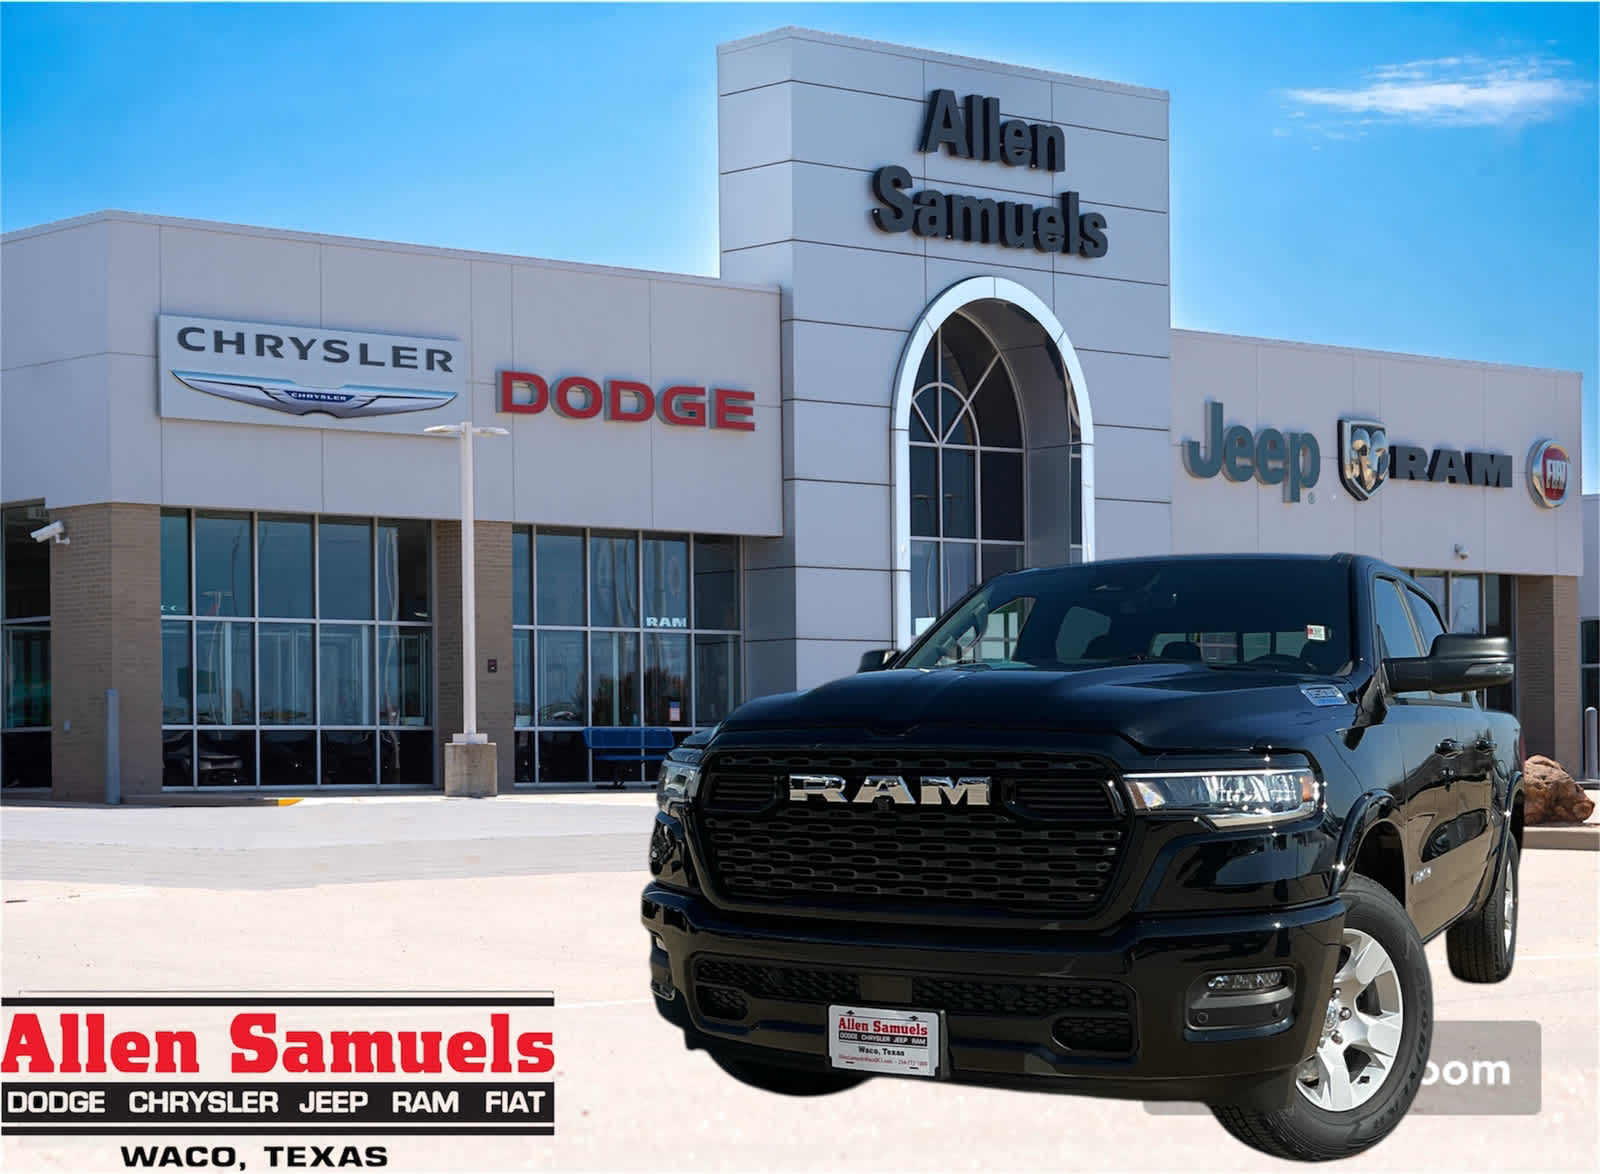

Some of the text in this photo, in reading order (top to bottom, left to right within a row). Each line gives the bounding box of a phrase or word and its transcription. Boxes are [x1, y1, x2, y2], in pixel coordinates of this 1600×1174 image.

[919, 89, 1065, 172] Allen
[872, 165, 1108, 258] Samuels
[177, 326, 454, 373] CHRYSLER
[290, 391, 347, 401] CHRYSLER
[495, 370, 755, 432] DODGE
[1182, 400, 1321, 503] Jeep
[1389, 445, 1512, 488] RAM
[646, 616, 687, 628] RAM
[788, 774, 991, 806] RAM
[838, 1017, 928, 1036] Allen Samuels
[861, 1034, 891, 1042] CHRYSLER
[858, 1046, 881, 1056] Waco,
